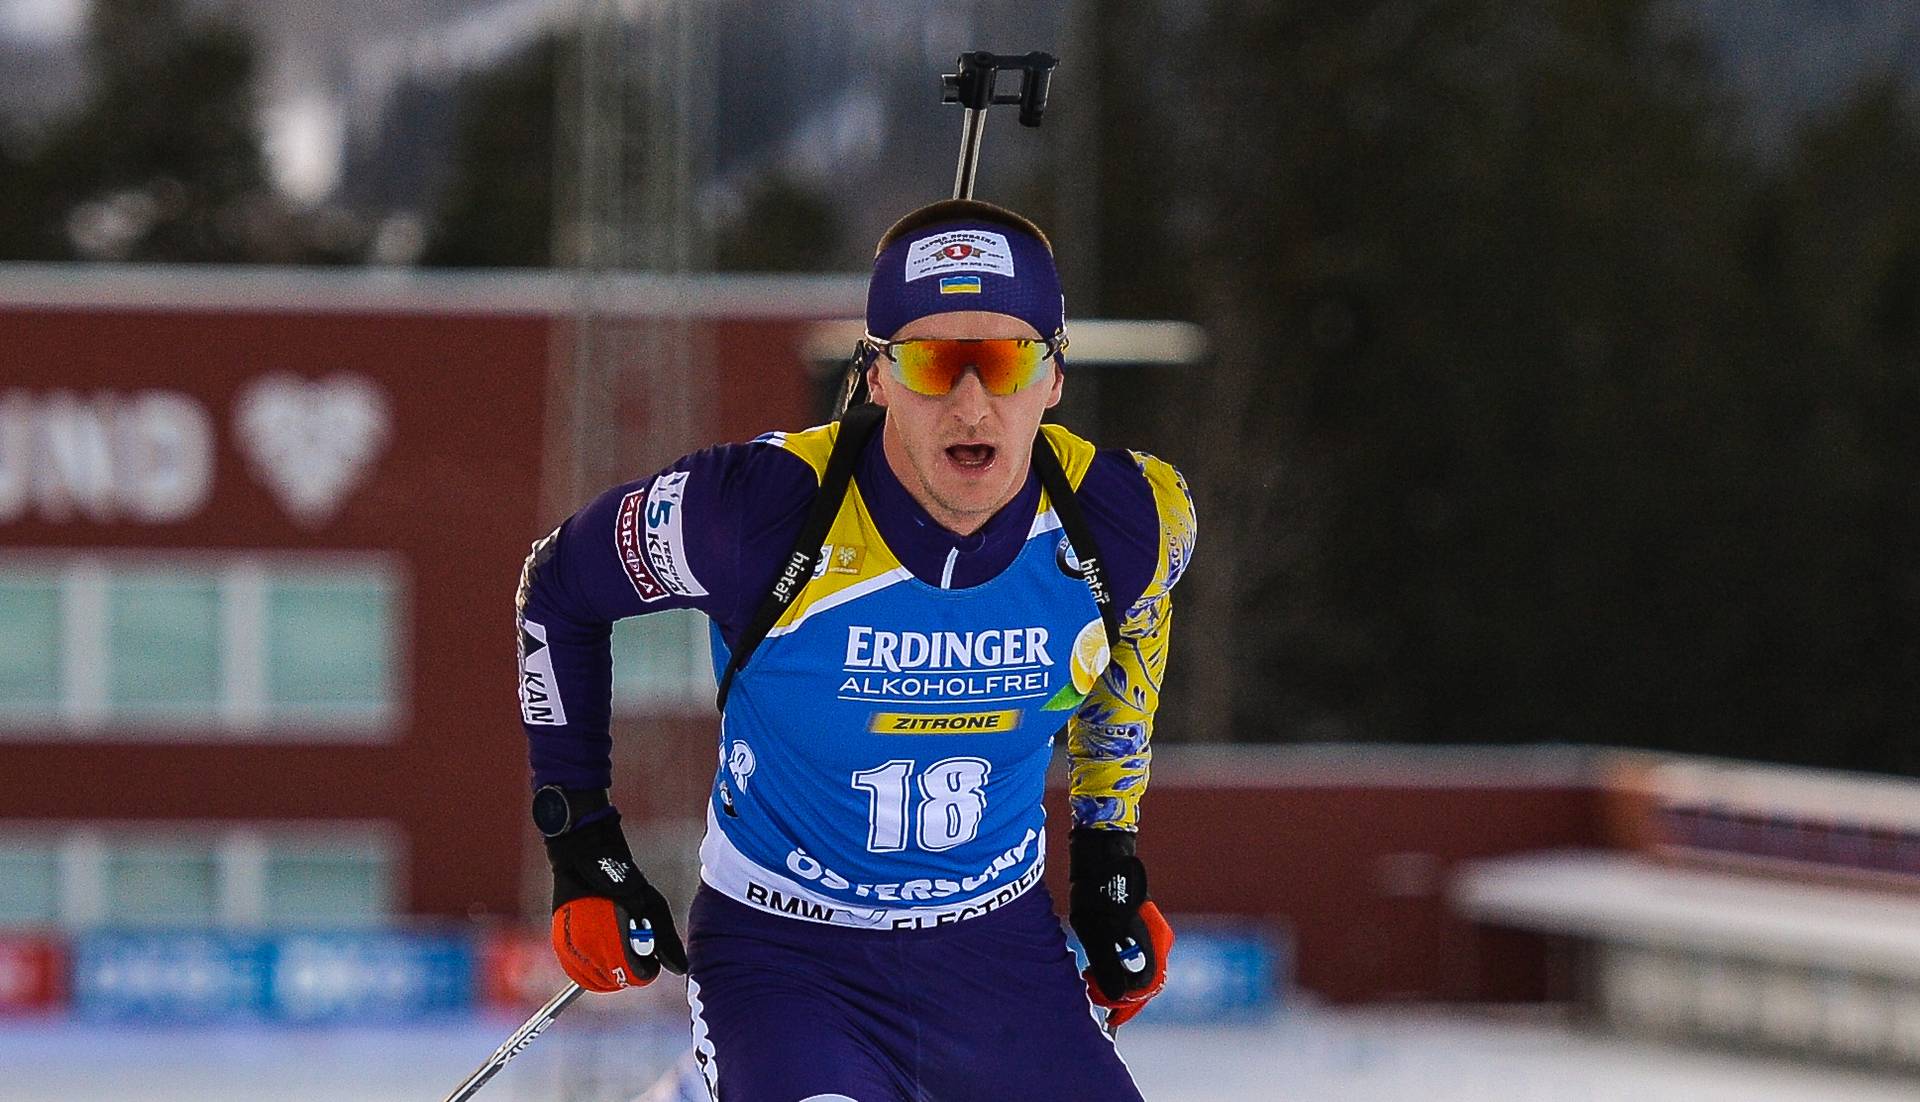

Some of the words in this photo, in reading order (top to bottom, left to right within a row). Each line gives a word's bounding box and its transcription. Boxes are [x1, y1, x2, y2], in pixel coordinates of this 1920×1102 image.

[844, 625, 1055, 672] ERDINGER
[838, 672, 1050, 697] ALKOHOLFREI
[892, 715, 1001, 730] ZITRONE
[851, 756, 992, 852] 18
